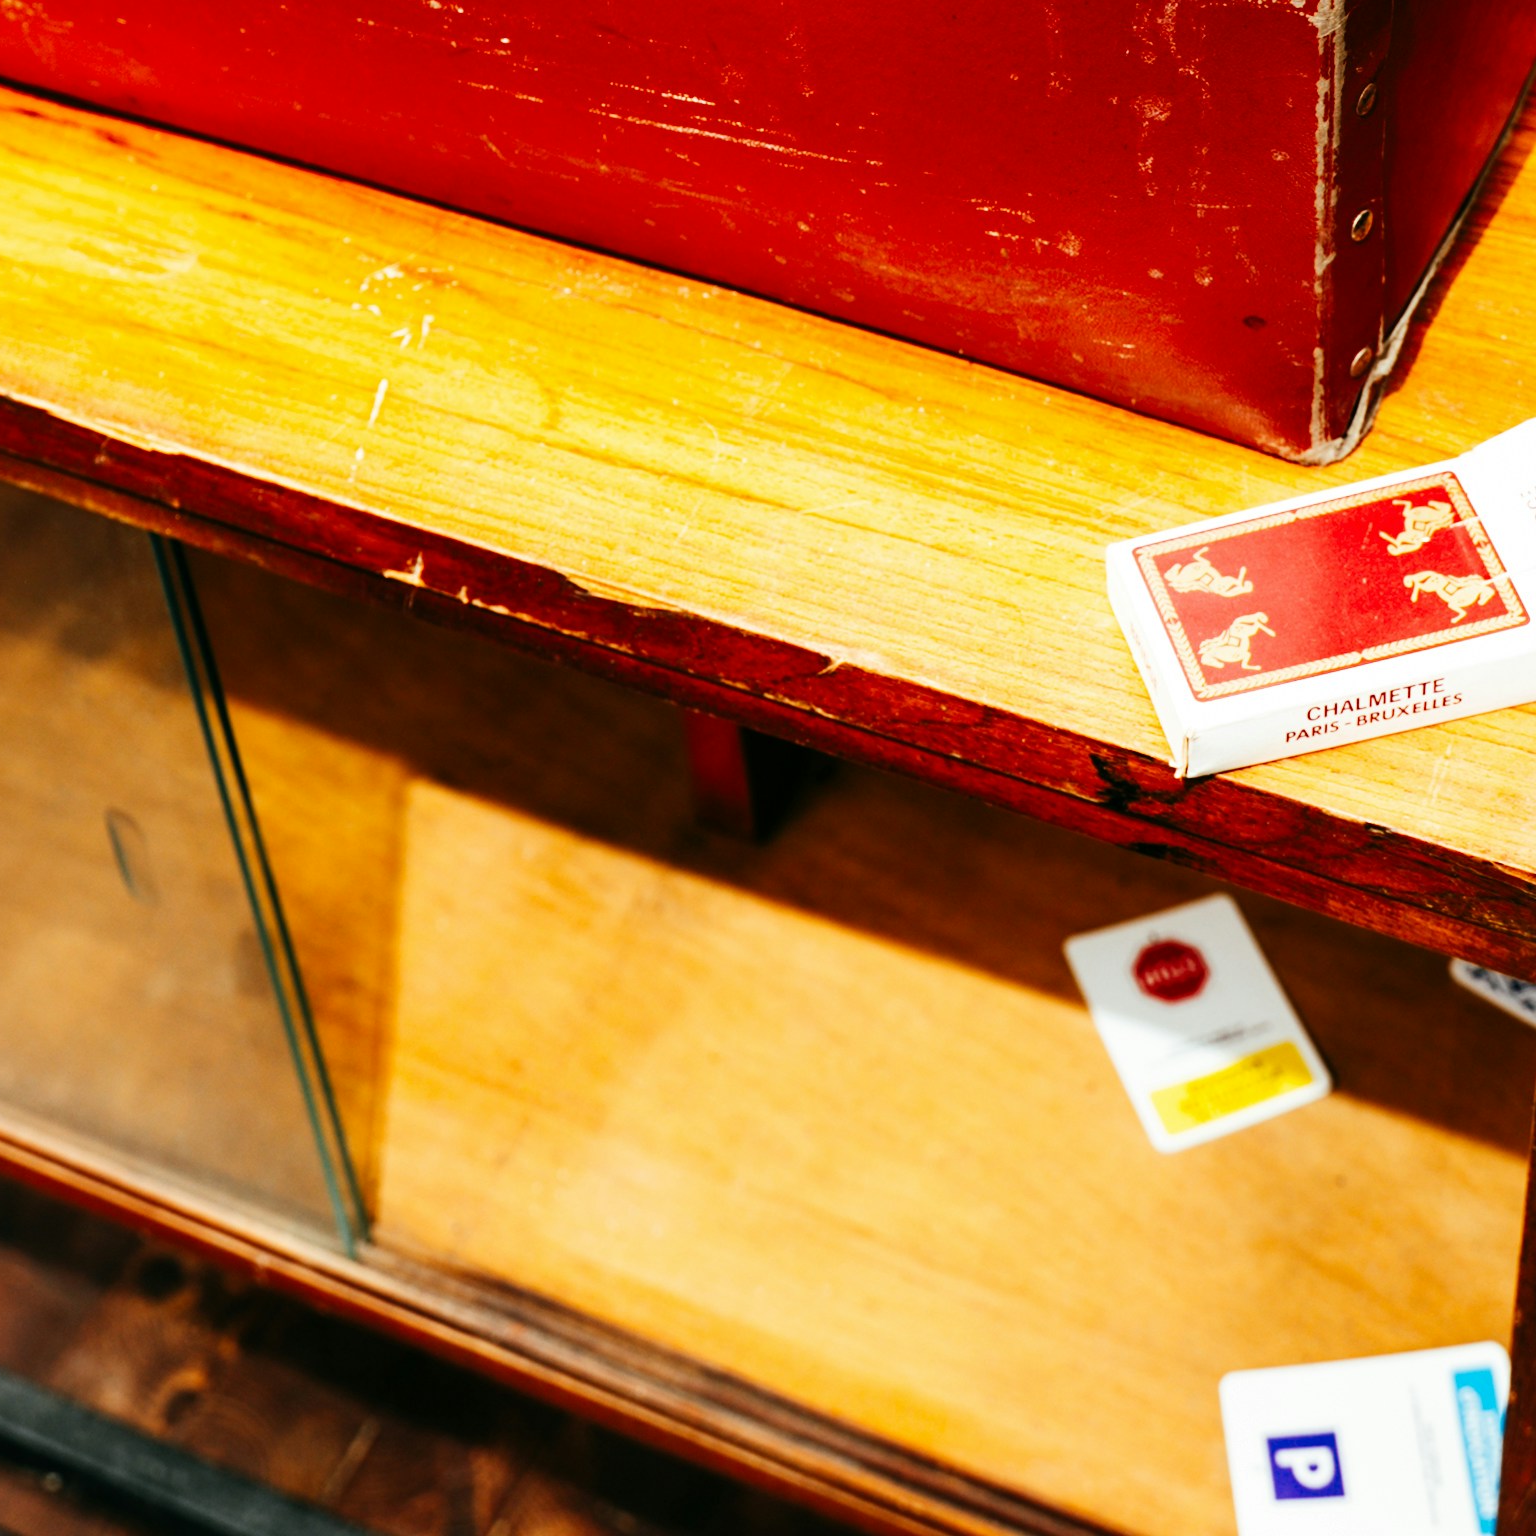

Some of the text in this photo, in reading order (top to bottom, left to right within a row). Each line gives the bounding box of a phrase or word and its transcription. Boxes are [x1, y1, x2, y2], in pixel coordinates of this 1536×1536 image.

[1285, 720, 1339, 743] PARIS
[1356, 693, 1463, 726] BRUXELLES
[1306, 677, 1446, 721] CHALMETTE
[1275, 1445, 1336, 1489] P
